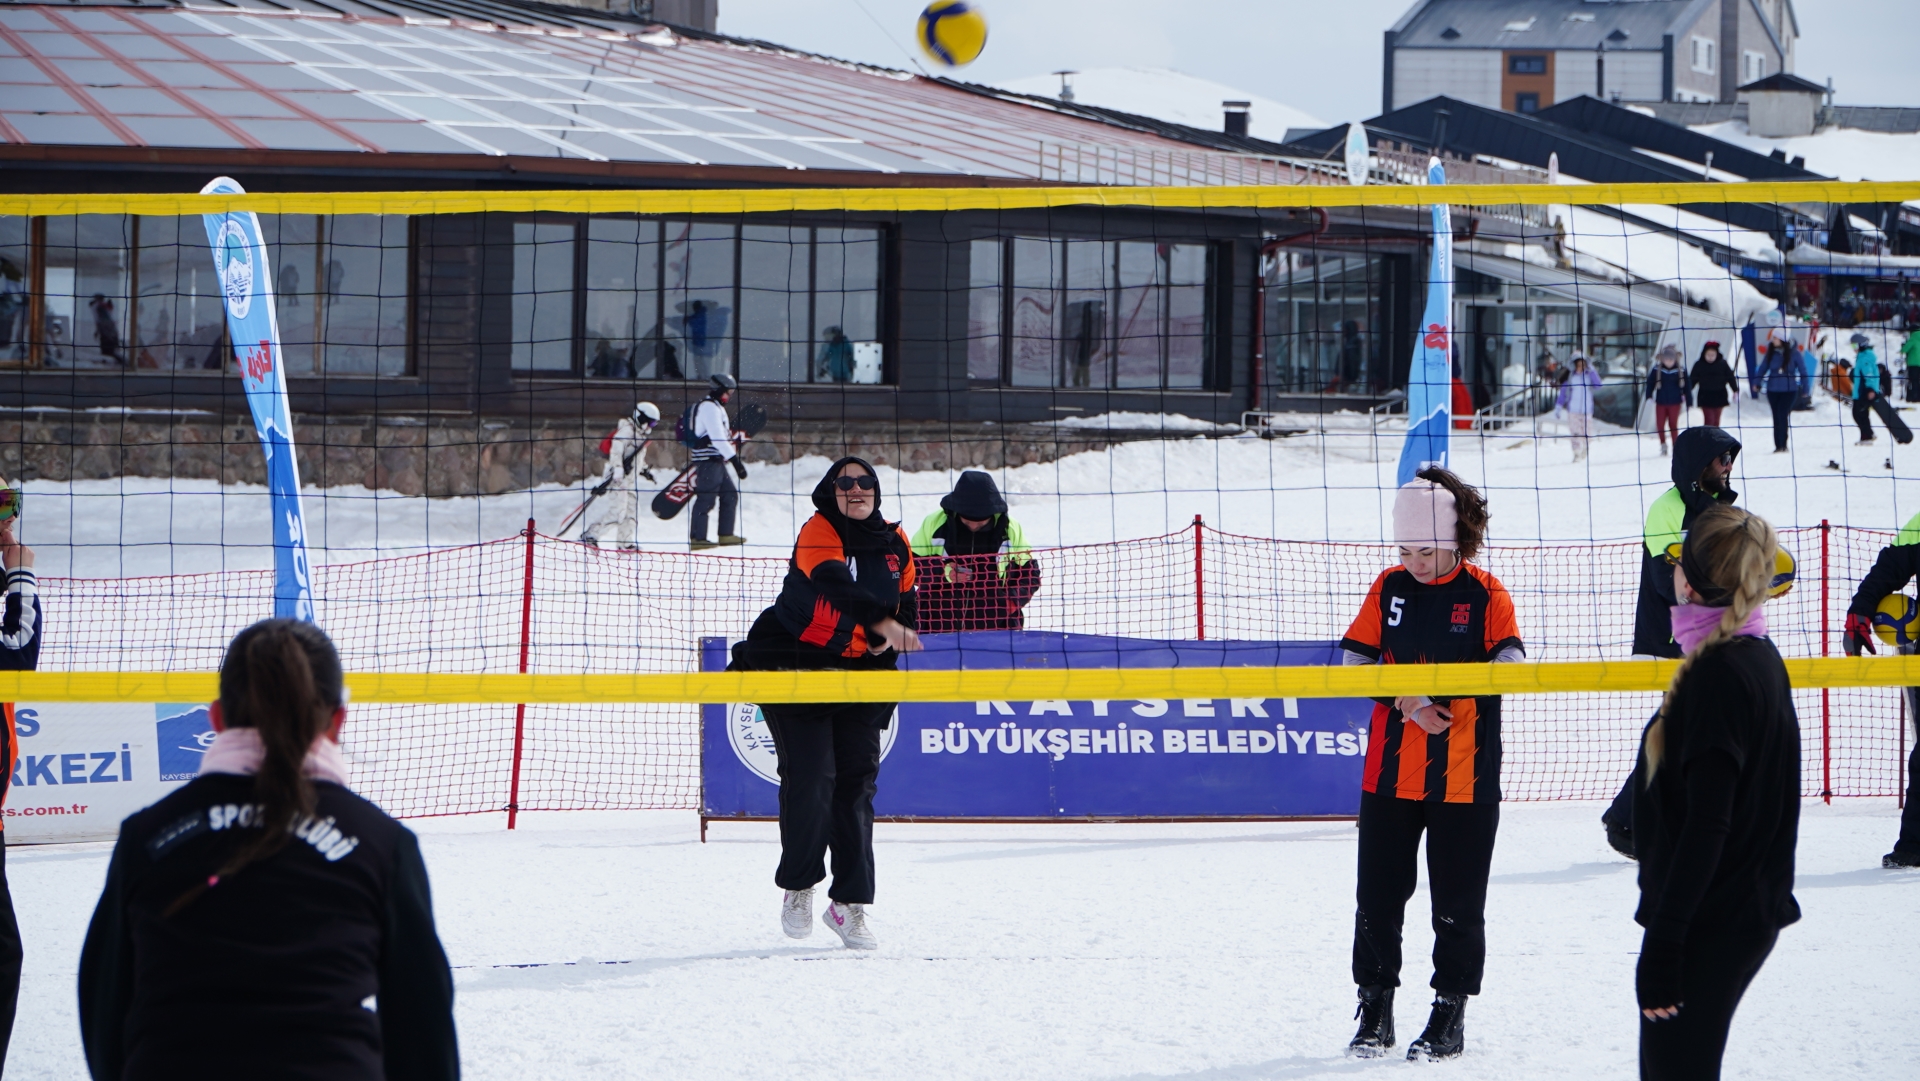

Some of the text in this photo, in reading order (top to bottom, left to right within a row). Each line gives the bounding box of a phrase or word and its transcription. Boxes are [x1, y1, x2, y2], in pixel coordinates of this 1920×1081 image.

[1387, 596, 1405, 627] 5
[920, 721, 1369, 762] BÜYÜKŞEHİR BELEDİYESİ
